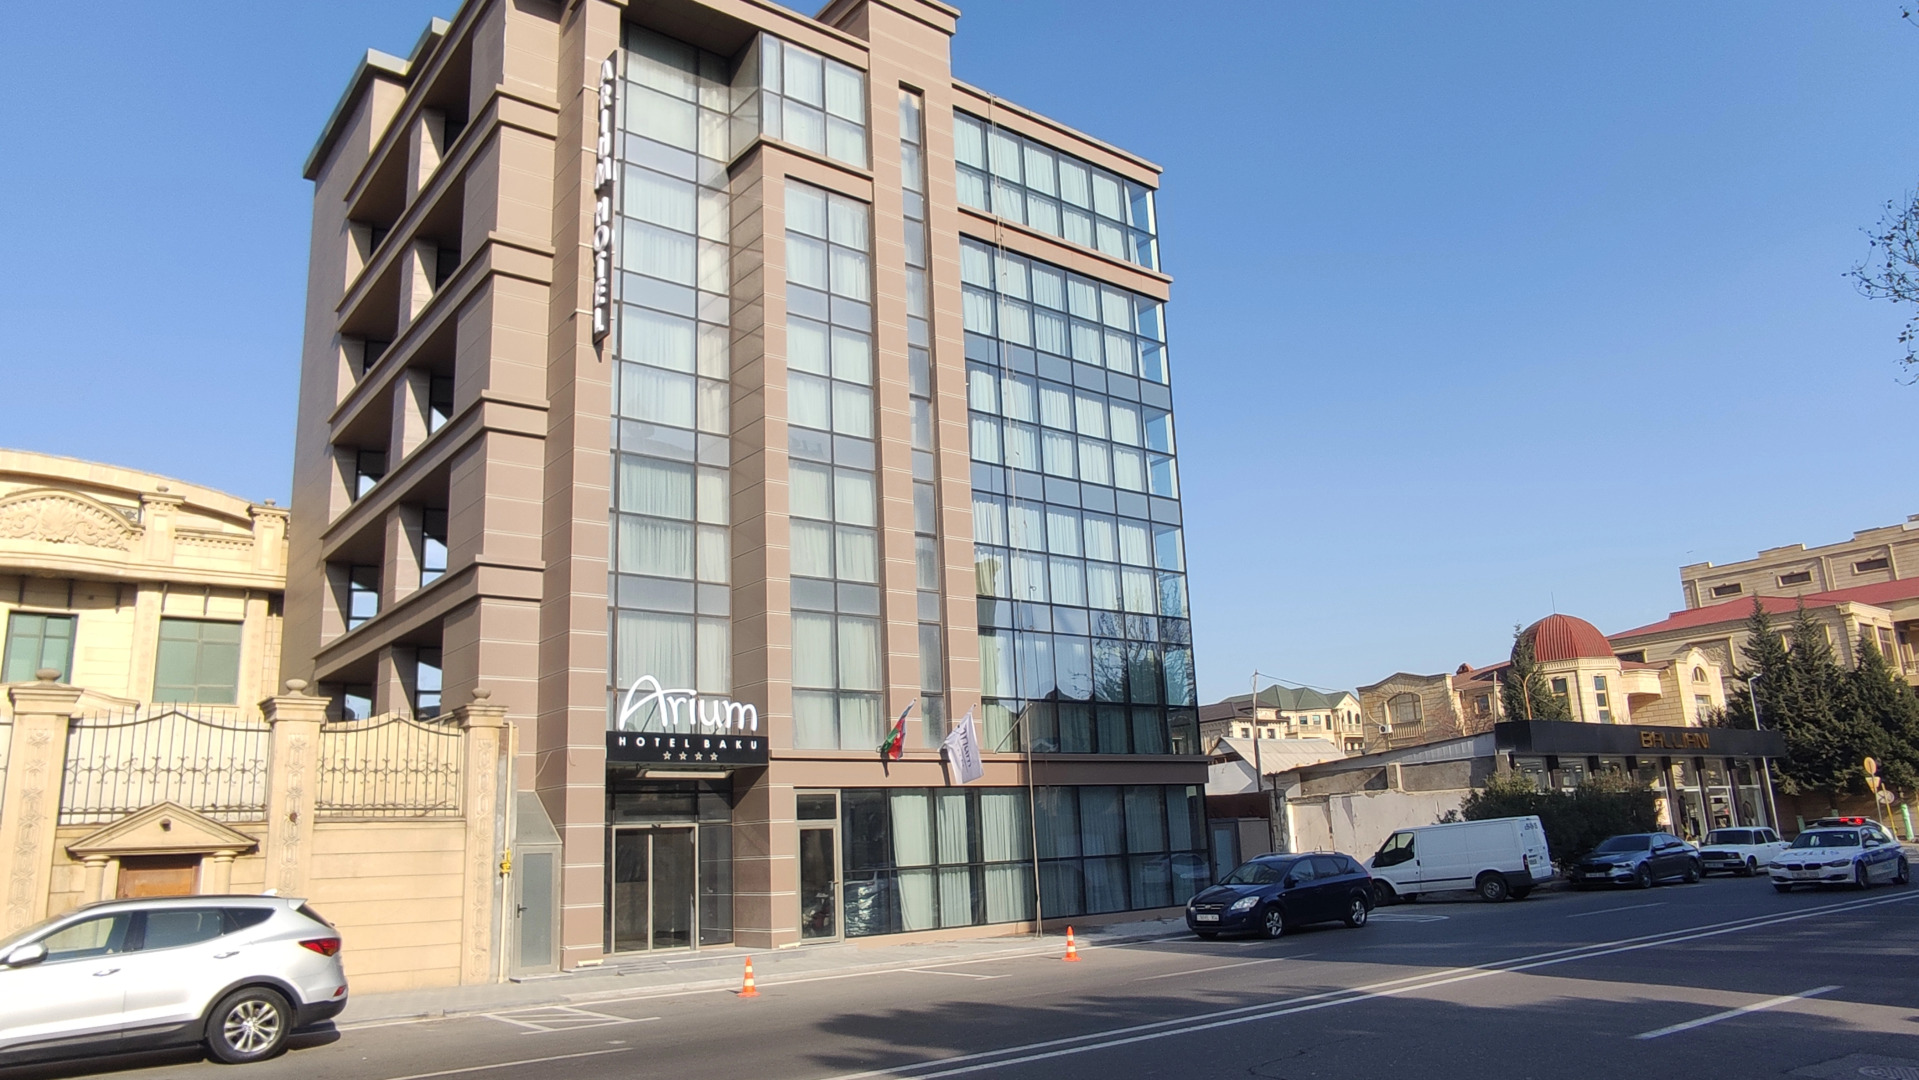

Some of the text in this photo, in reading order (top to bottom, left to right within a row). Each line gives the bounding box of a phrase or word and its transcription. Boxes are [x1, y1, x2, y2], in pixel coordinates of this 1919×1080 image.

[593, 59, 614, 332] ARIUM HOTEL
[618, 675, 758, 731] Arium
[618, 736, 758, 750] HOTEL BAKU
